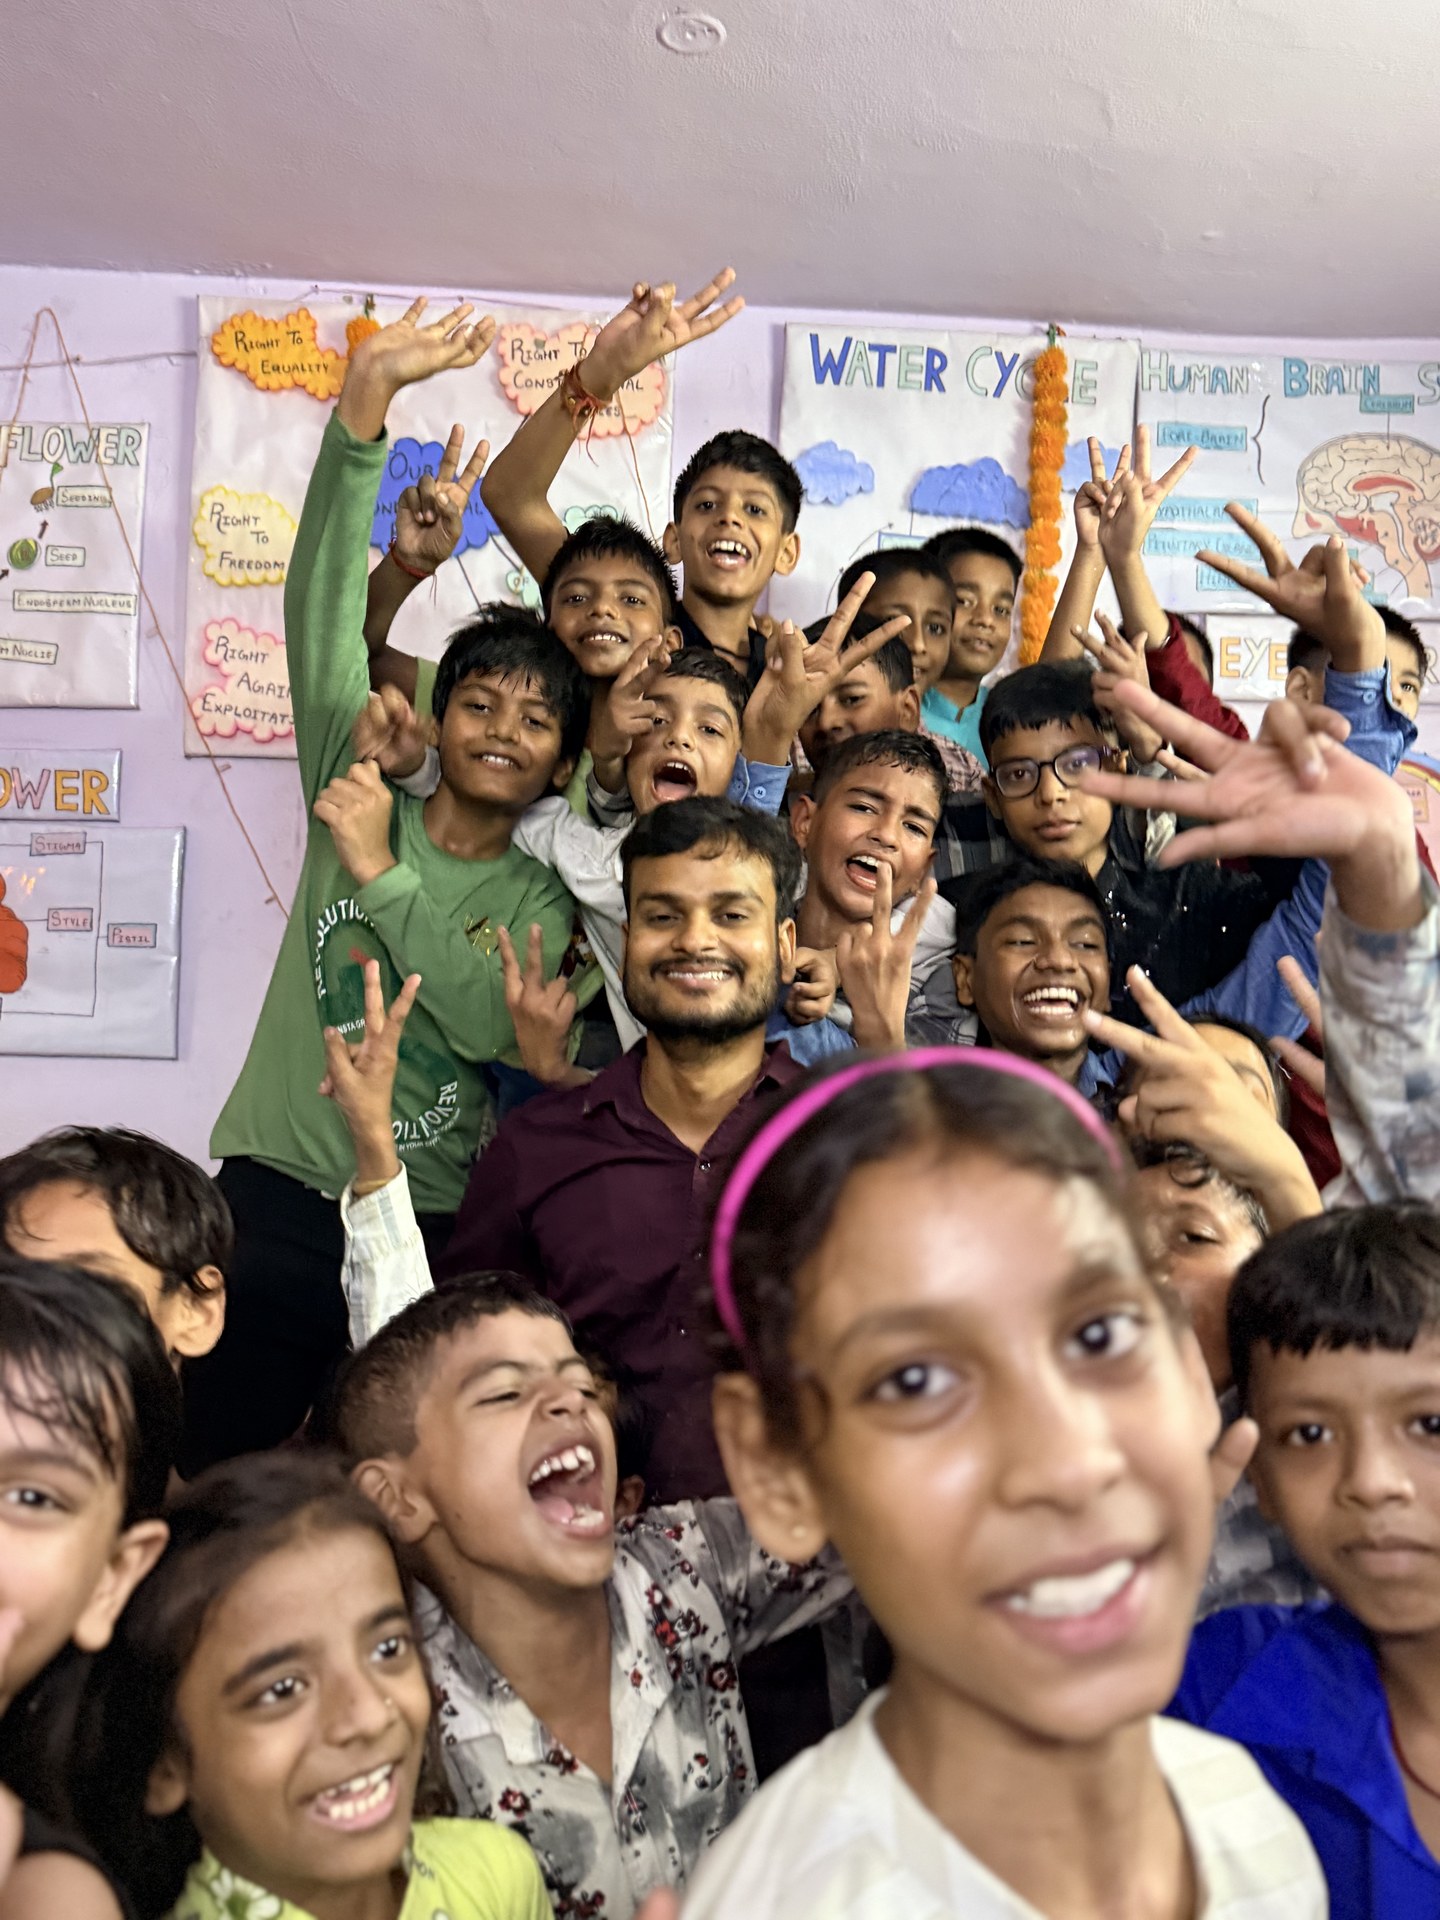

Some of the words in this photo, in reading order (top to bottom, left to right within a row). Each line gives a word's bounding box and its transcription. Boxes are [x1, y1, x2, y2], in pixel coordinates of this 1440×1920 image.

[234, 330, 280, 352] RIGHT
[287, 331, 303, 345] TO
[511, 338, 560, 366] RIGHT
[568, 341, 587, 359] TO
[261, 359, 330, 375] EQUALITY
[809, 333, 948, 393] WATER
[966, 345, 1098, 405] CYCE
[1141, 350, 1249, 394] HUMAN
[1283, 357, 1380, 398] BRAIN
[0, 425, 141, 467] FLOWER
[210, 502, 260, 535] RIGHT
[250, 530, 269, 544] TO
[50, 547, 78, 562] SEED
[219, 551, 285, 570] FREEDOM
[214, 635, 268, 663] RIGHT
[1220, 636, 1289, 681] EYE
[51, 911, 89, 927] STYLE
[112, 927, 150, 944] PISTIL
